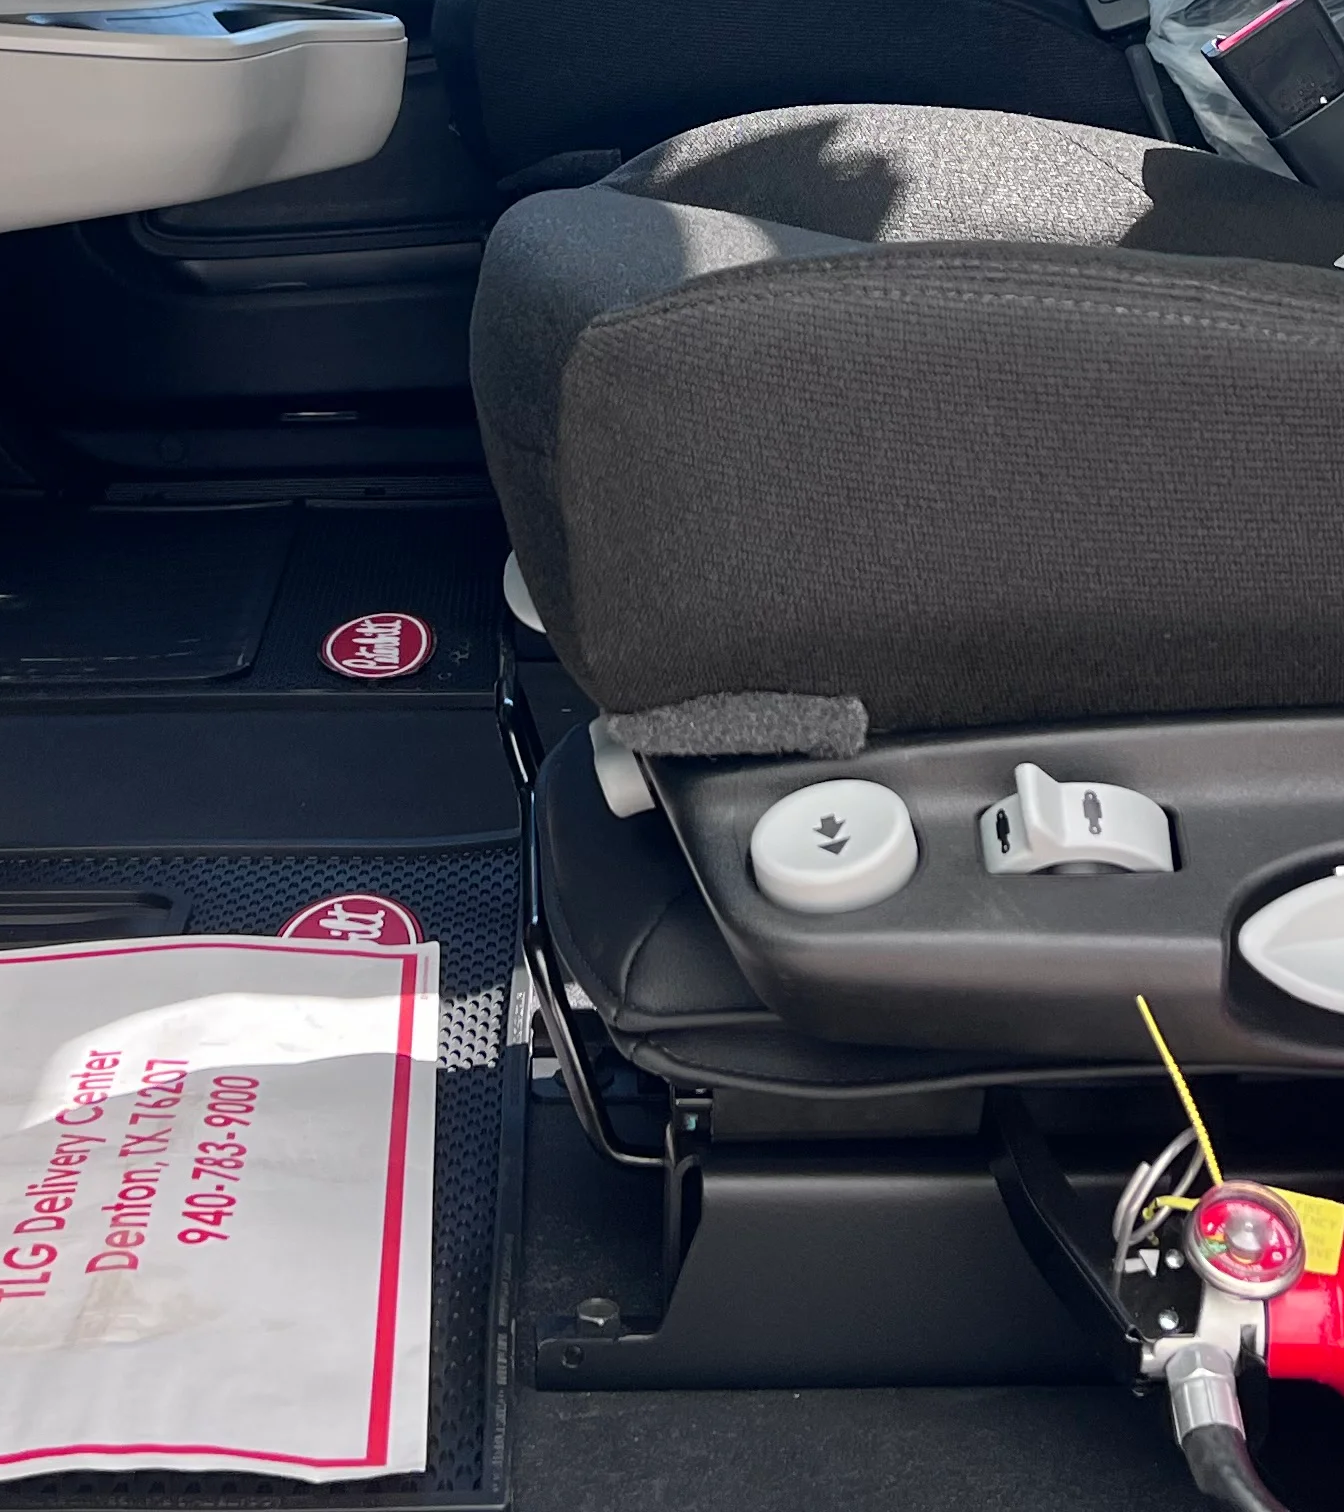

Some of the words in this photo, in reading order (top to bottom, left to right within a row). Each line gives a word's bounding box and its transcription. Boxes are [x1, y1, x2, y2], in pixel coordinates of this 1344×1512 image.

[54, 1049, 122, 1126] Center
[128, 1059, 189, 1126] 76207
[12, 1133, 107, 1235] Delivery
[117, 1127, 172, 1157] TX
[177, 1075, 260, 1245] 940-783-9000
[84, 1161, 170, 1274] Denton,
